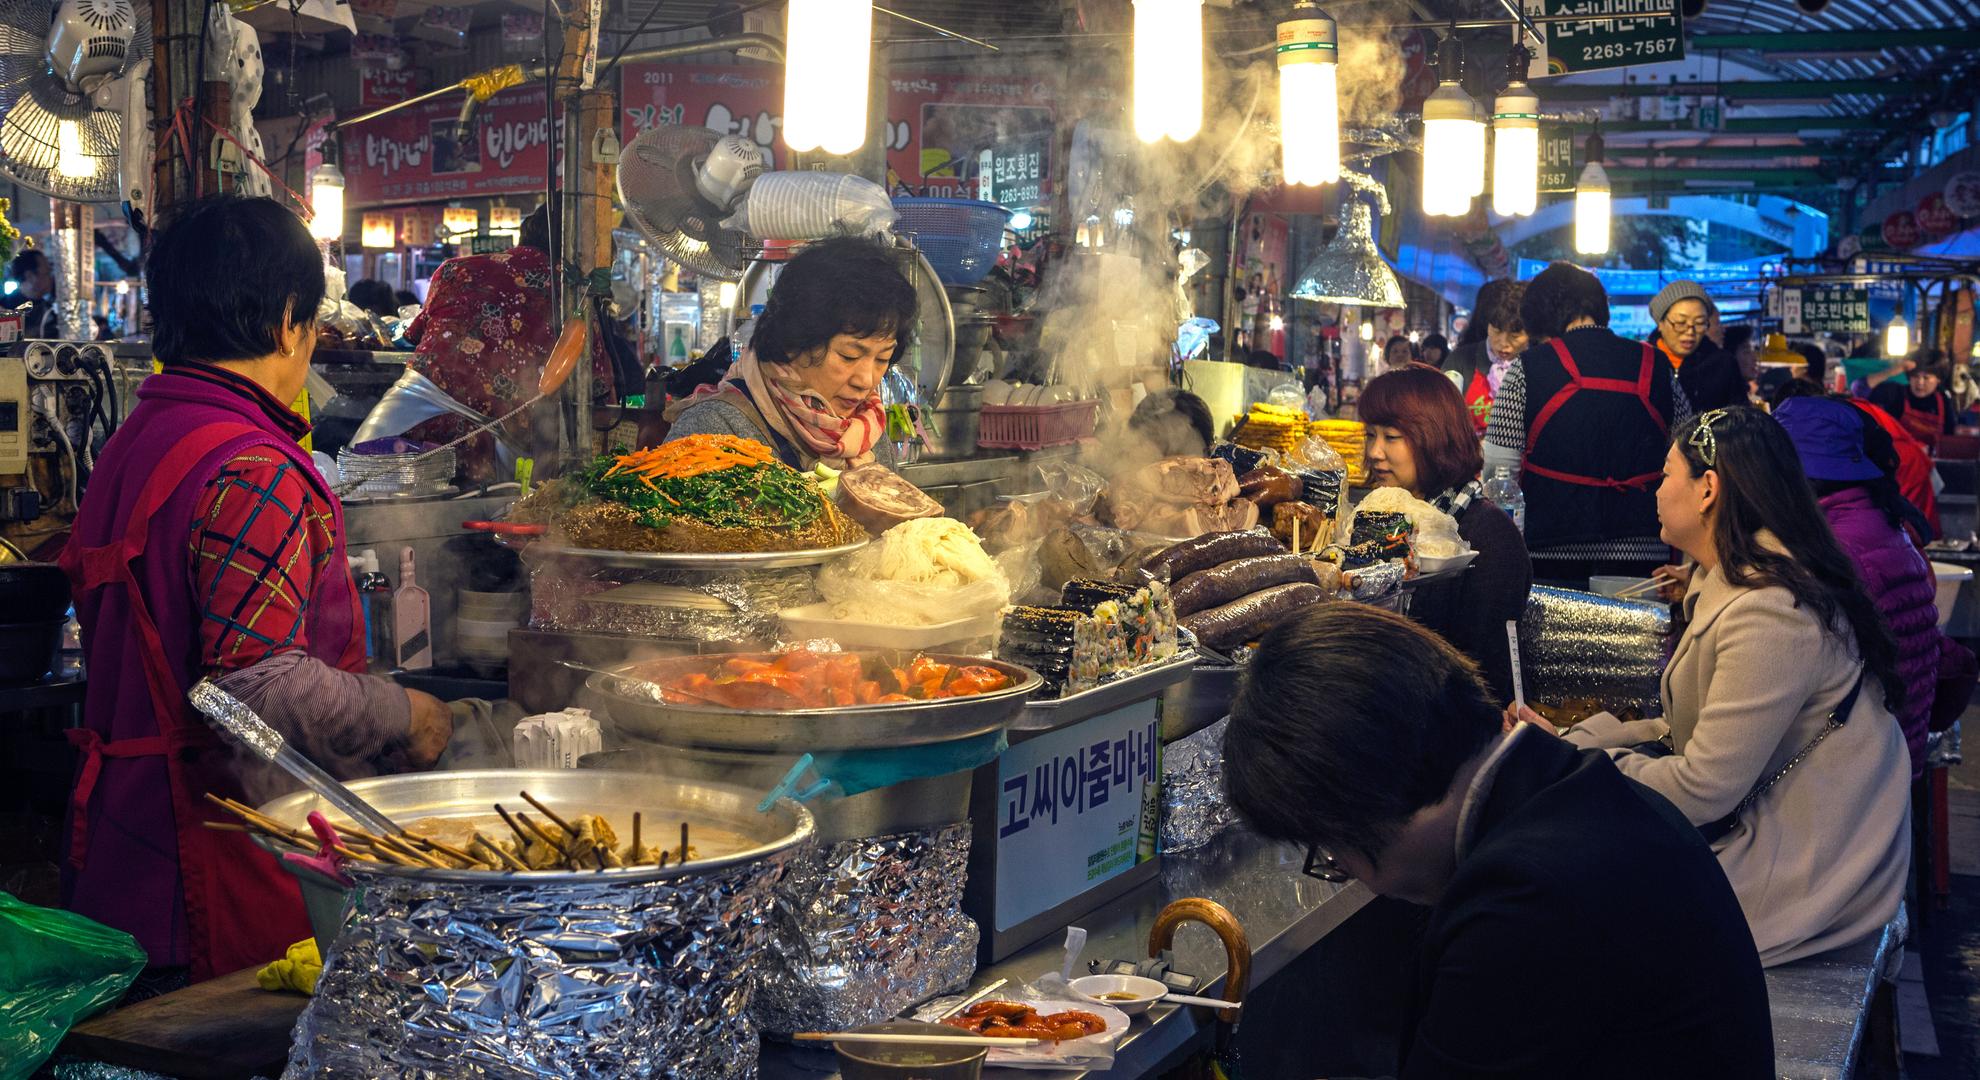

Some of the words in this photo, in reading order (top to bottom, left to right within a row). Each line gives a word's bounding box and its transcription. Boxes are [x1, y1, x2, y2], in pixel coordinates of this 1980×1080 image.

[1583, 37, 1677, 61] 2263-7567
[643, 72, 673, 84] 2011
[366, 133, 429, 176] 박가네
[995, 152, 1039, 183] 원조횟집
[1000, 185, 1038, 203] 2263-8932
[1804, 301, 1867, 319] 원조빈대떡
[1000, 720, 1157, 839] 고씨아줌마네
